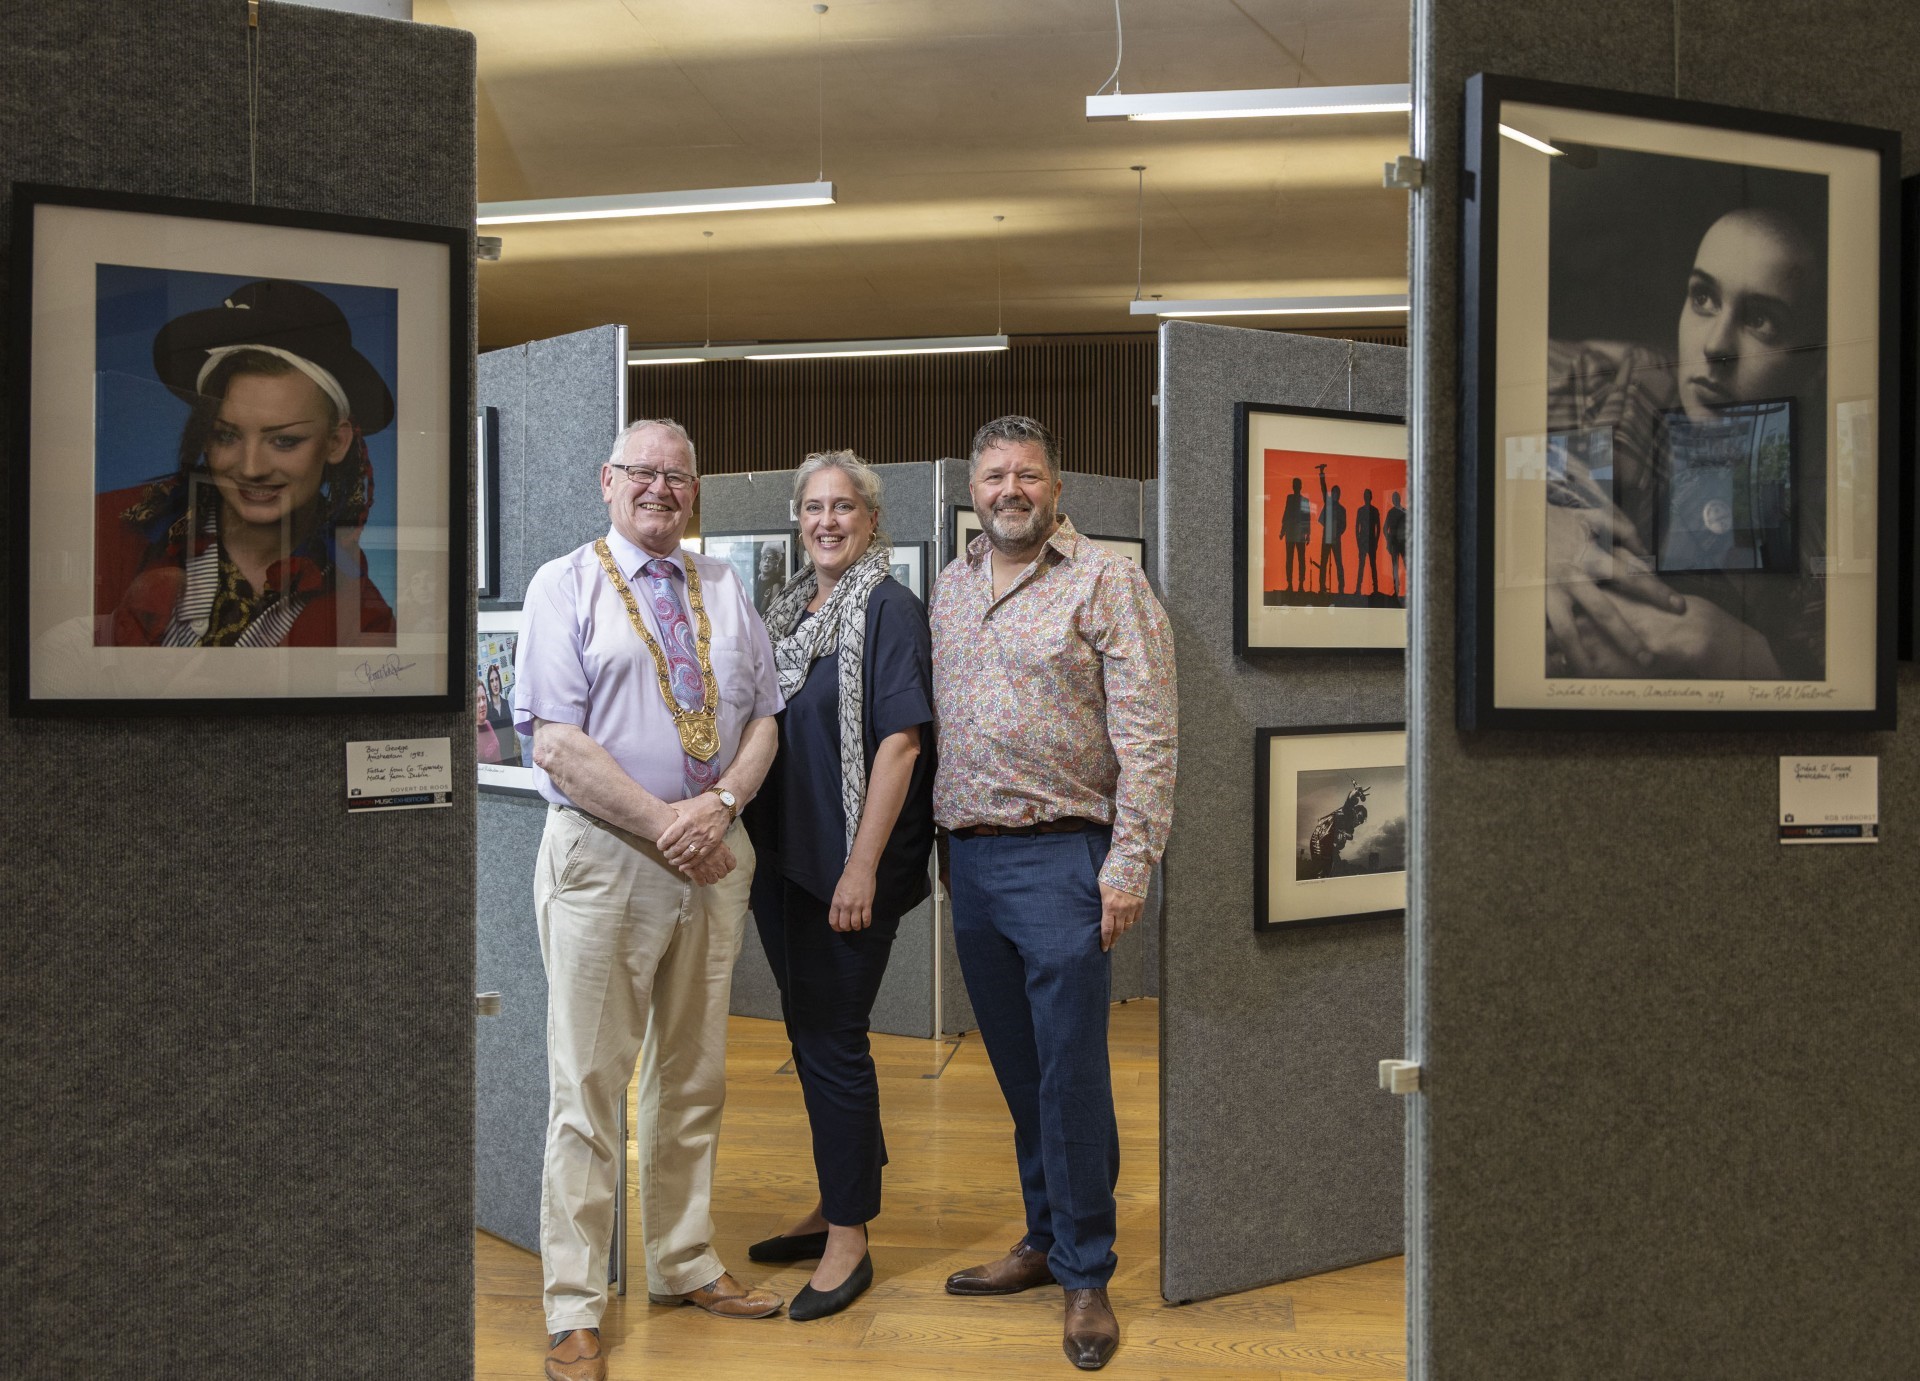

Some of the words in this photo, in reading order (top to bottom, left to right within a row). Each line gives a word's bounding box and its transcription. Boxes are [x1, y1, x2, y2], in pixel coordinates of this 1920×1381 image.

[365, 745, 379, 754] Boy
[385, 744, 409, 753] George
[366, 753, 403, 762] Amsterdam
